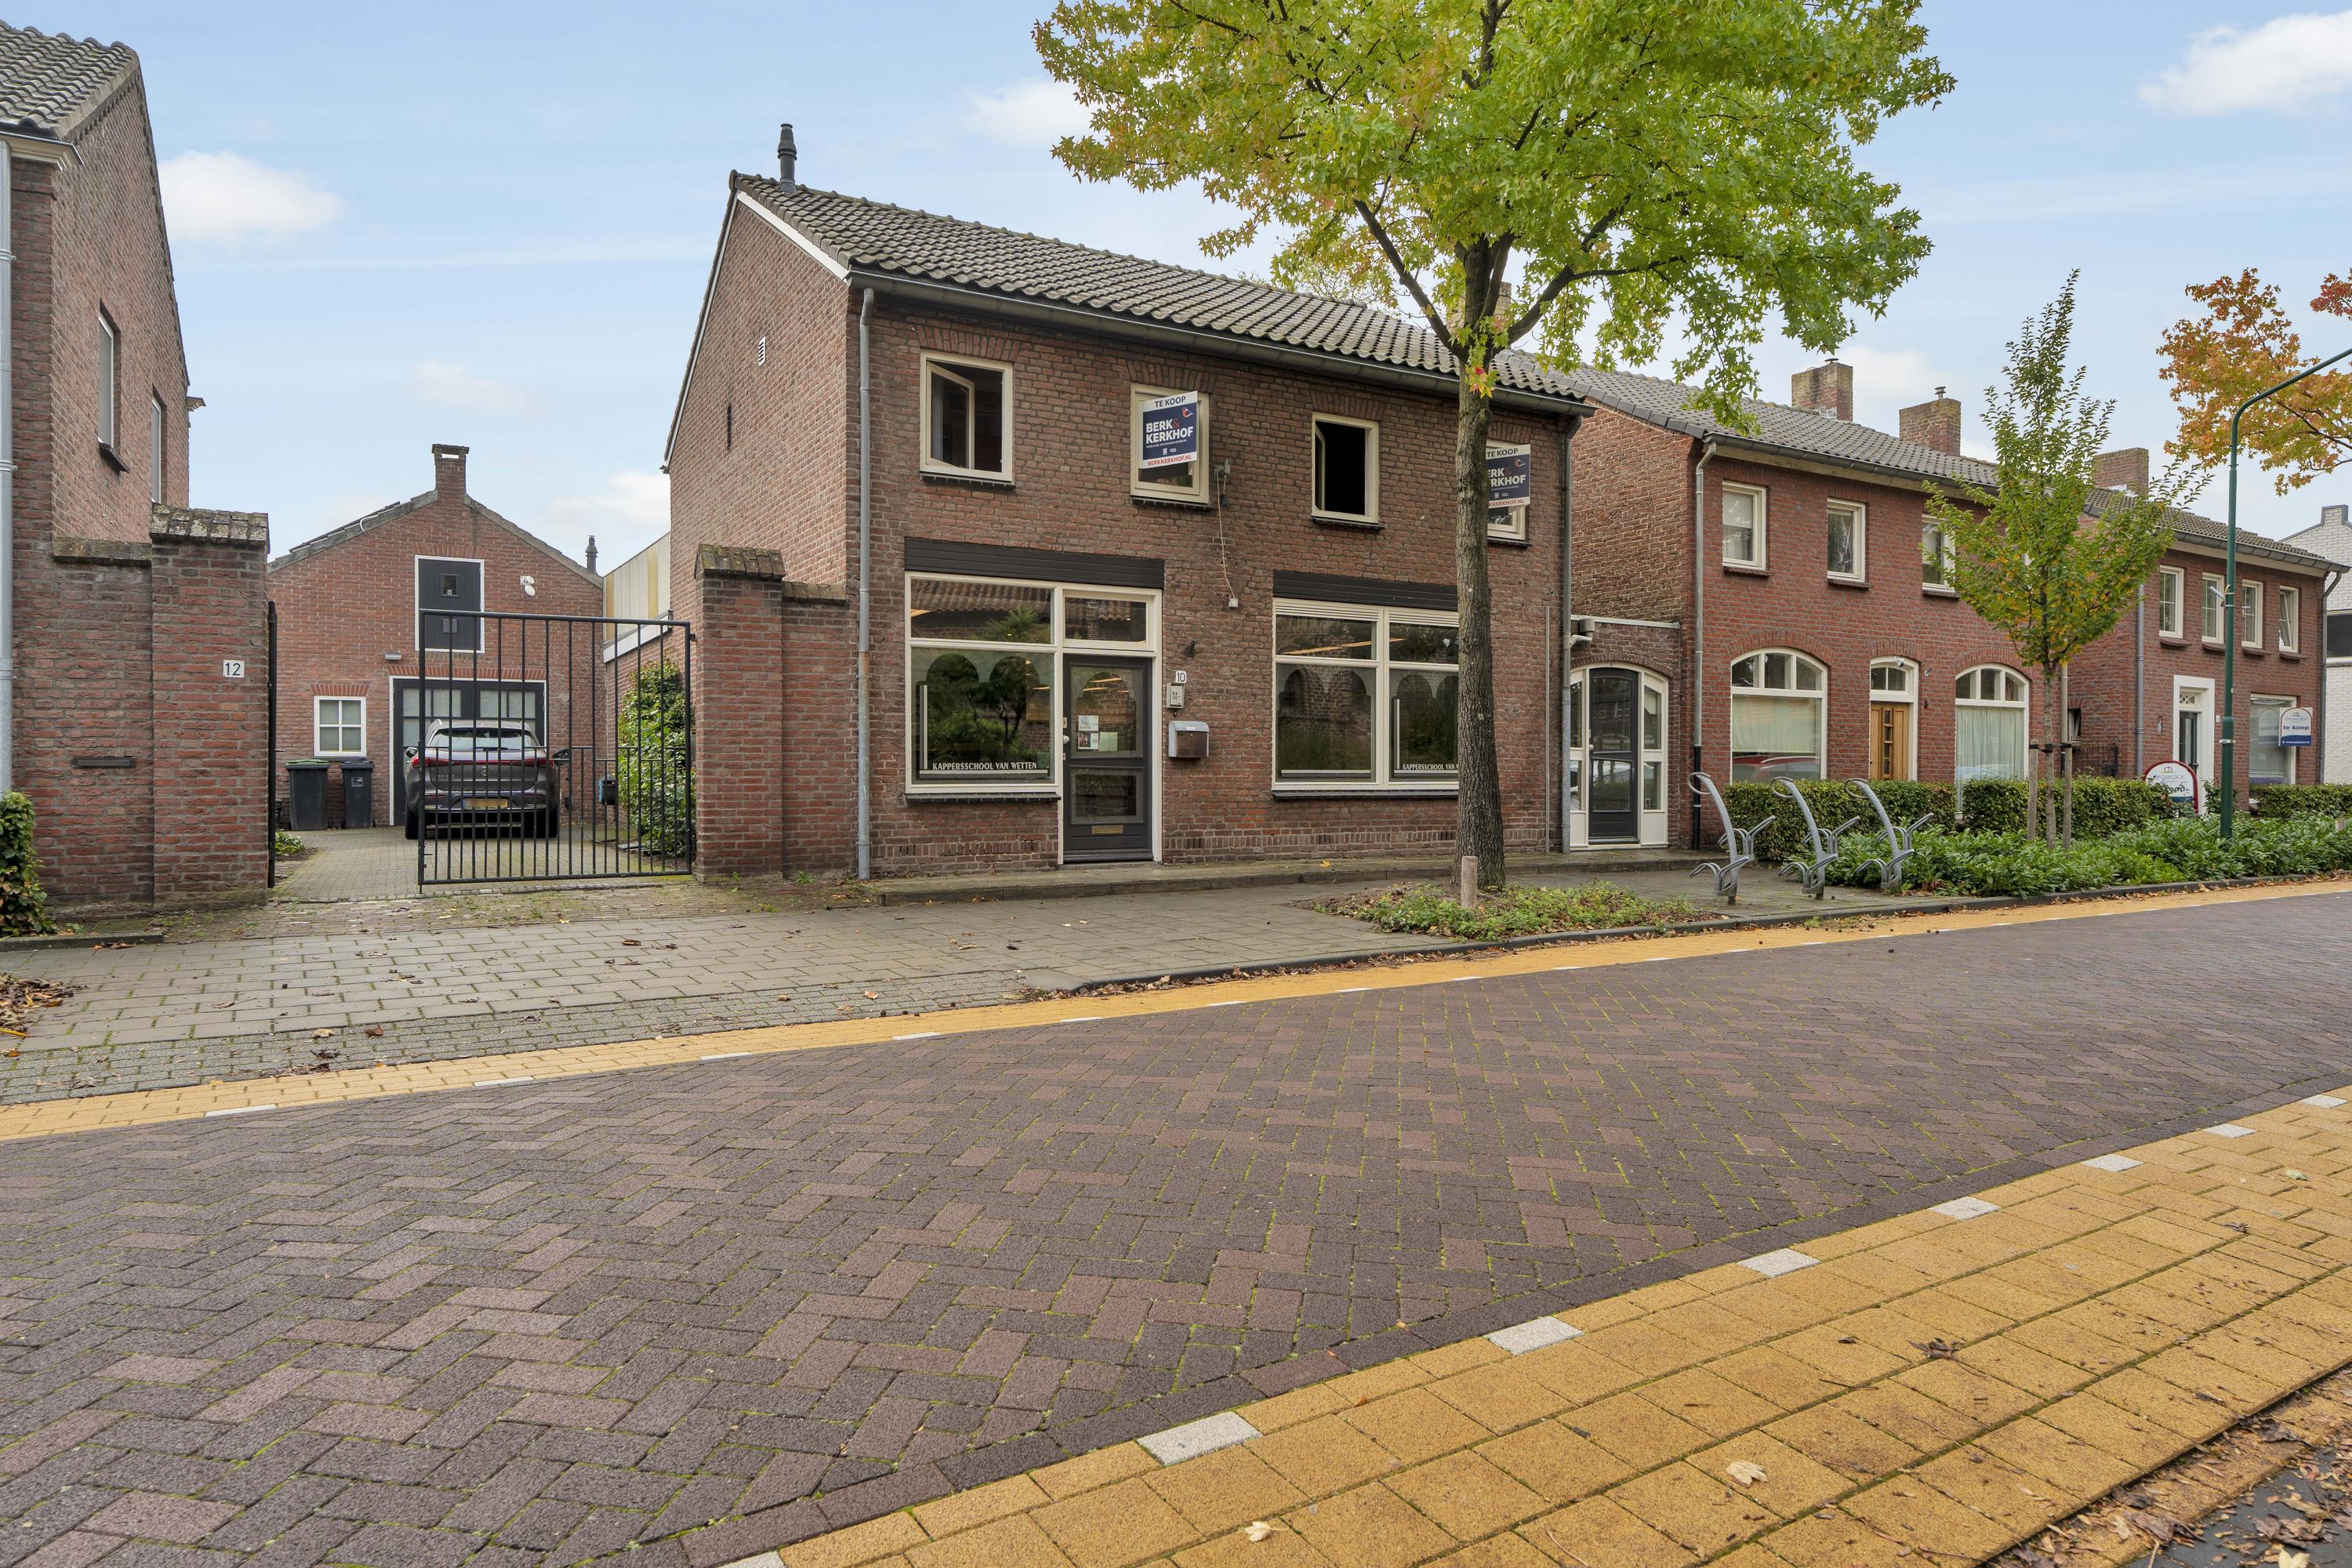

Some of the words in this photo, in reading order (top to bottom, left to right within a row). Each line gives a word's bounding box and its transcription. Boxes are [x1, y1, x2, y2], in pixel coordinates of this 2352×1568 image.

[1165, 396, 1186, 406] KOOP
[1145, 426, 1193, 445] KERKHOF
[1497, 448, 1519, 456] KOOP
[1147, 455, 1192, 466] BERKKERKHOF.NL
[1490, 474, 1526, 488] RKHOF
[225, 662, 241, 676] 12
[1177, 672, 1186, 682] 10
[932, 762, 994, 771] KAPPERSSCHOOL
